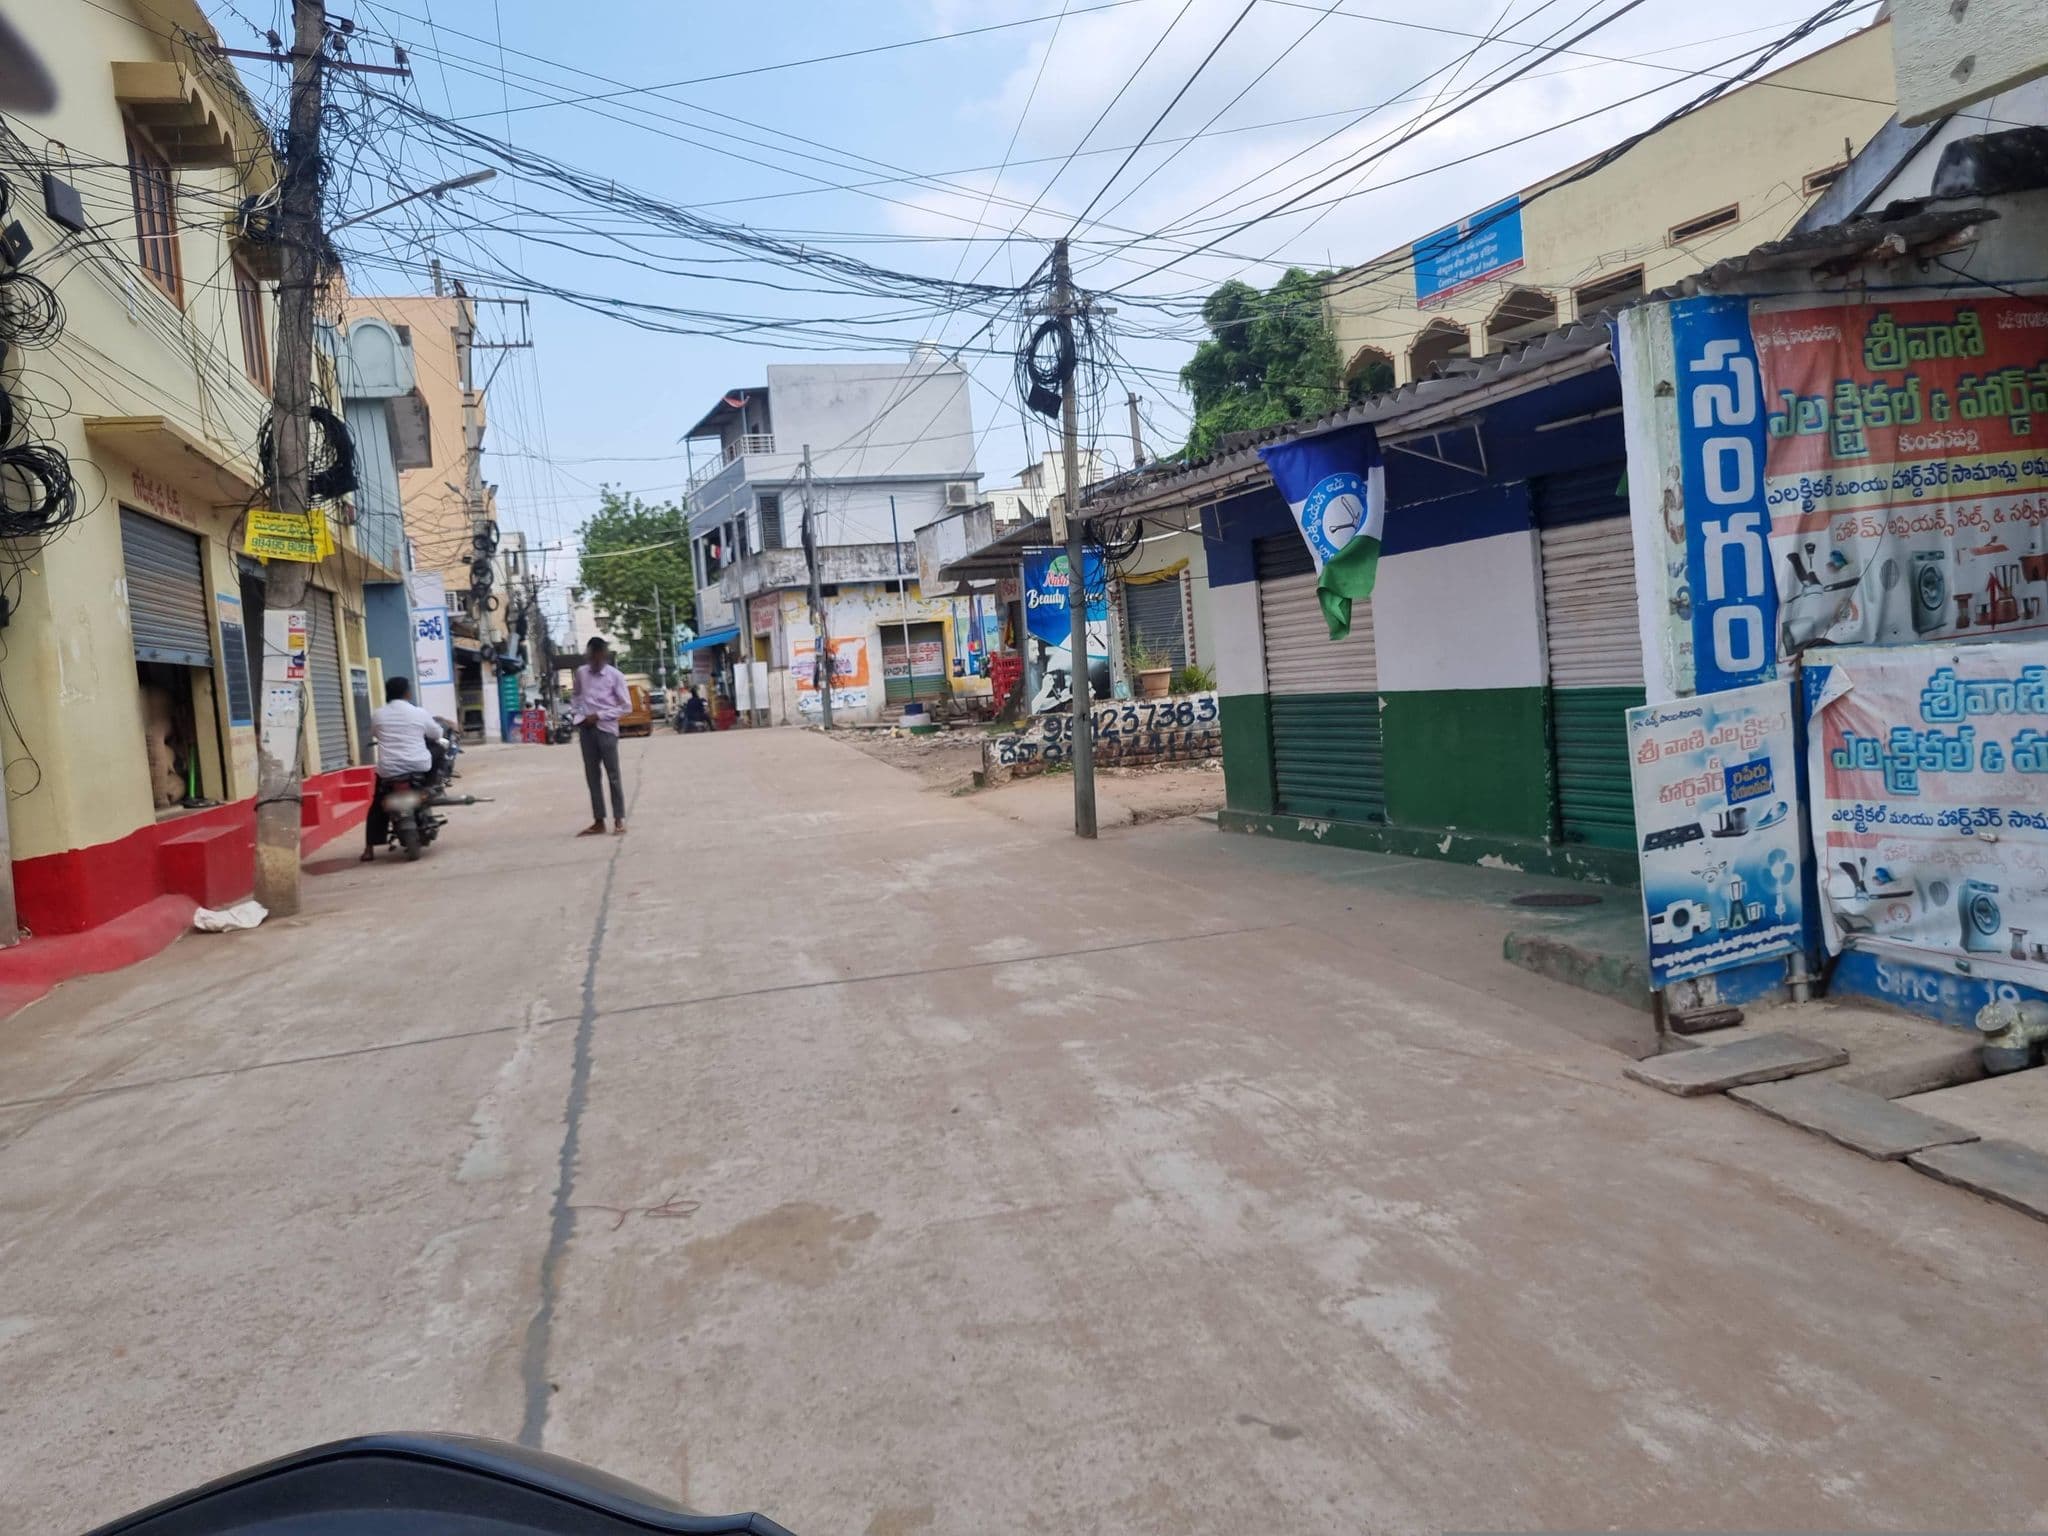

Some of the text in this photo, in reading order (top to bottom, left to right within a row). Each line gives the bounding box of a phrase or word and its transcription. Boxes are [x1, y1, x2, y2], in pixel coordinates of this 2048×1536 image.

[1863, 309, 1986, 371] శ్రీవాణి
[1835, 477, 1888, 497] మరియు
[1689, 338, 1768, 674] సంగం
[1994, 508, 2005, 523] &
[1026, 588, 1066, 610] Beauty
[1889, 812, 1934, 826] మరియు
